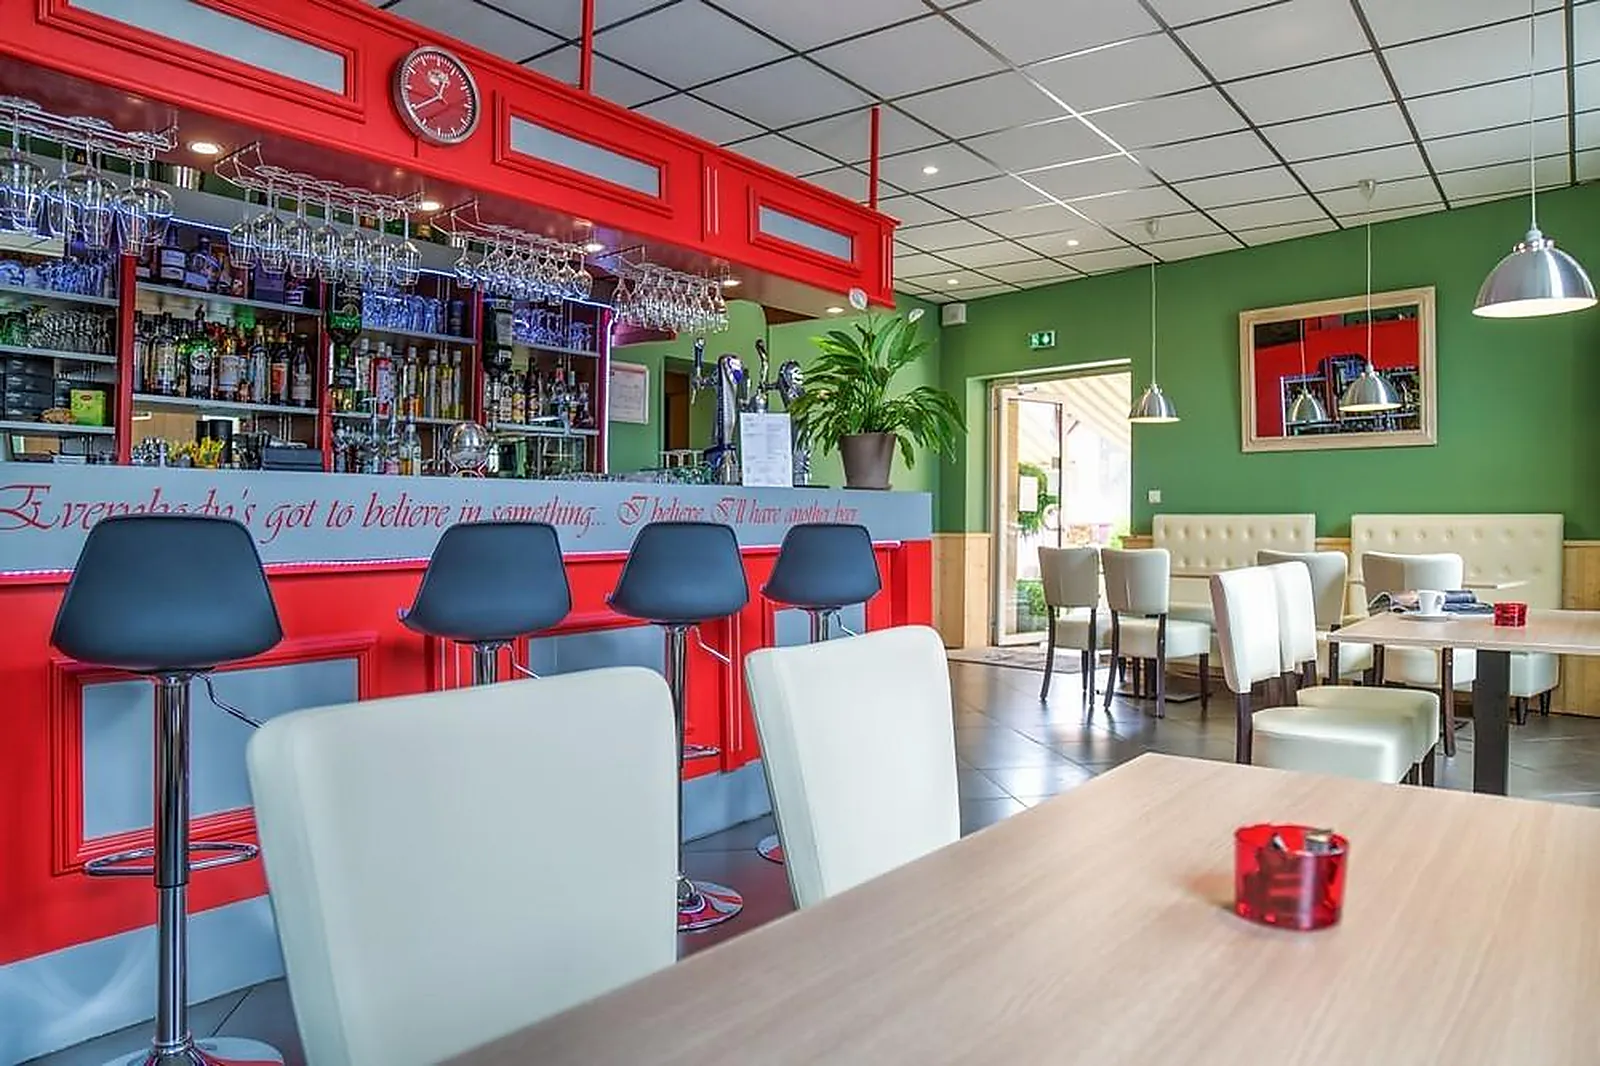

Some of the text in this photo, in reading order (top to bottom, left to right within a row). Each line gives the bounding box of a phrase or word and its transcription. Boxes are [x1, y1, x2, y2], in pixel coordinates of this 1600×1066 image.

[260, 499, 316, 544] got
[326, 500, 355, 528] to
[362, 492, 450, 528] believe
[458, 499, 481, 522] in
[617, 495, 649, 526] I
[650, 497, 705, 522] believe
[749, 499, 781, 524] have
